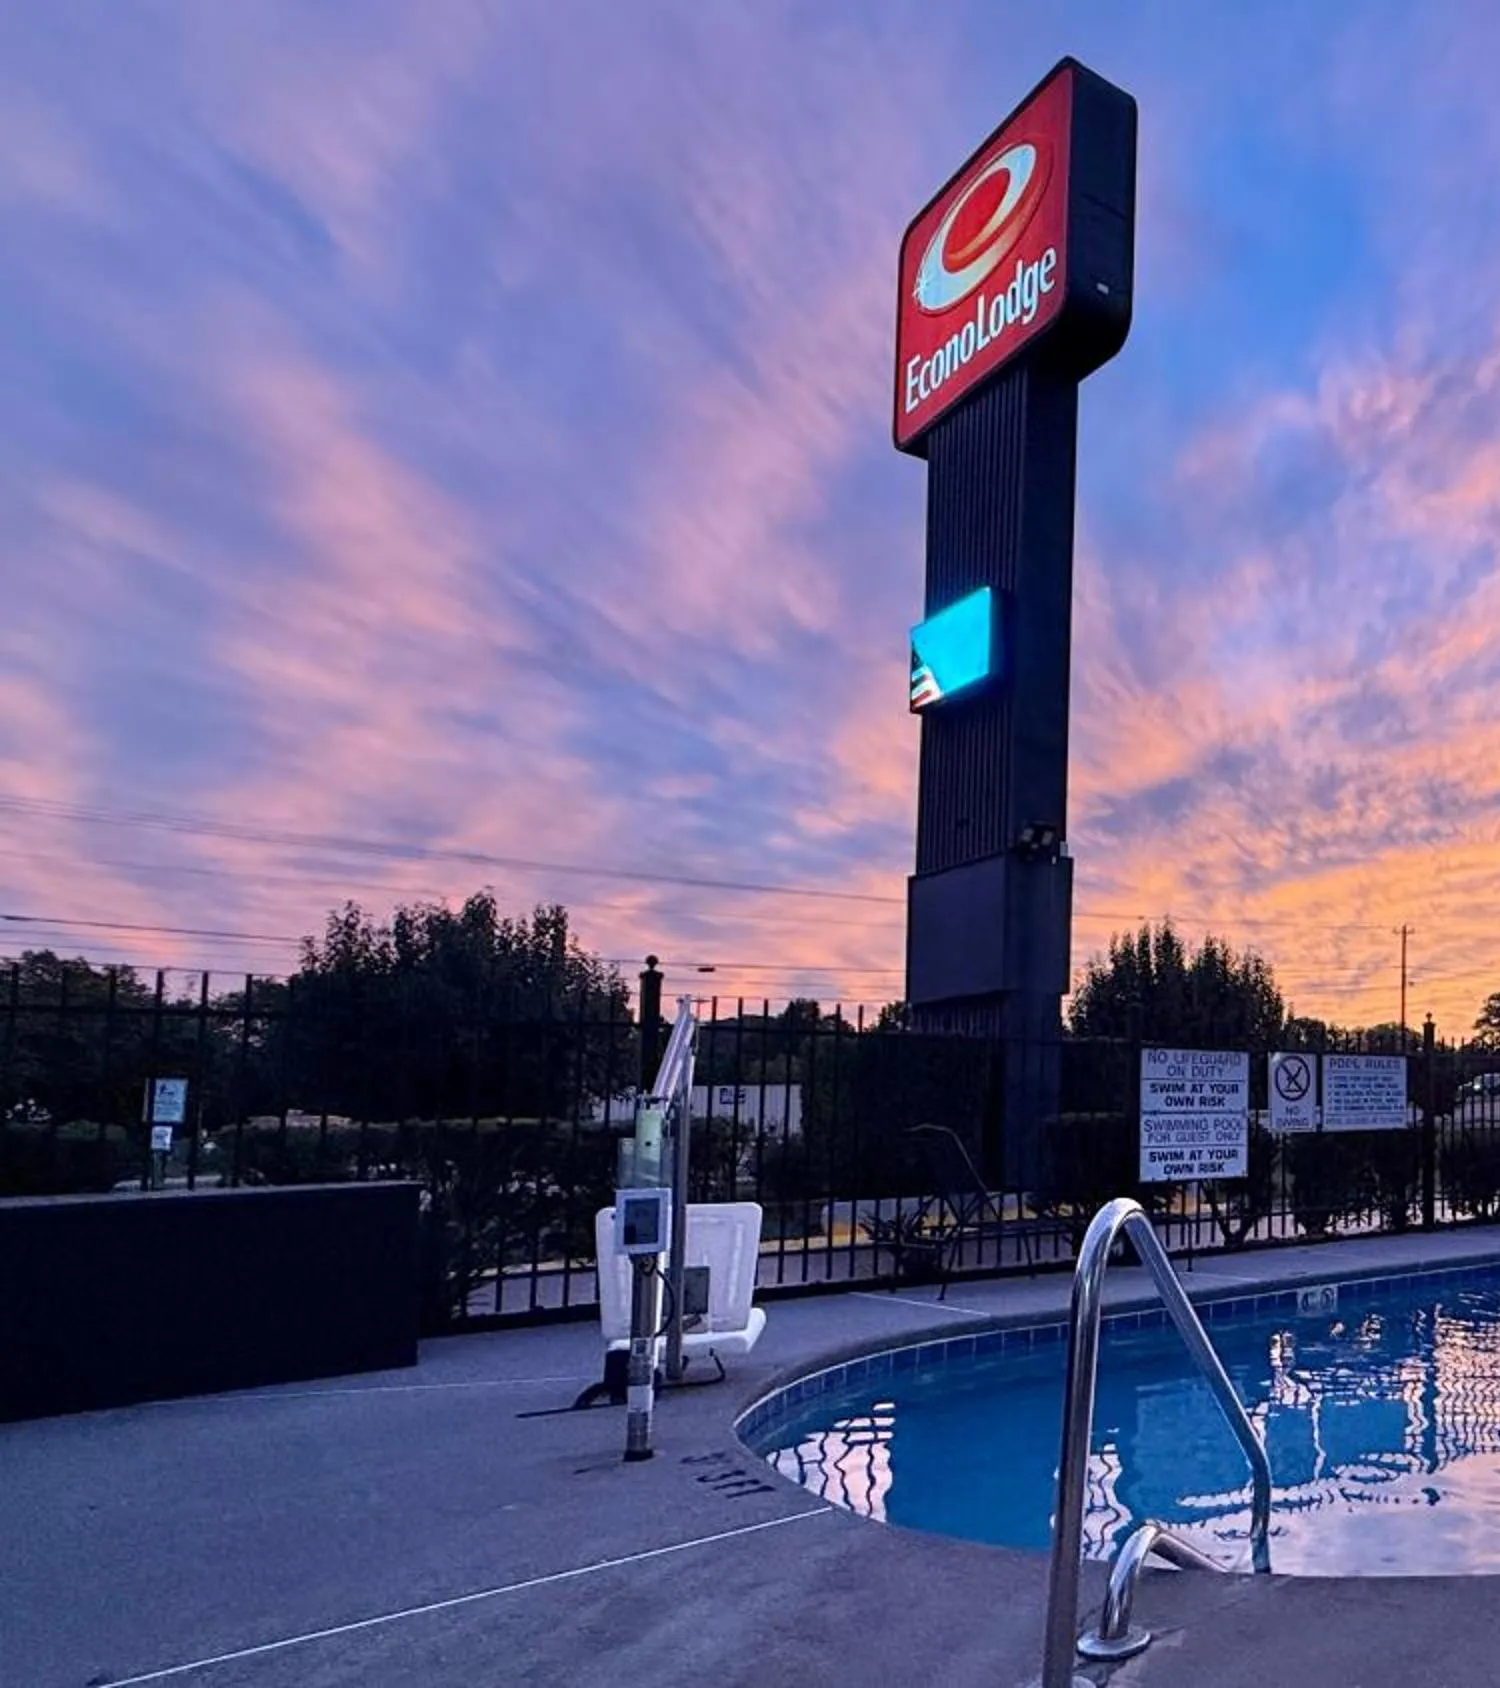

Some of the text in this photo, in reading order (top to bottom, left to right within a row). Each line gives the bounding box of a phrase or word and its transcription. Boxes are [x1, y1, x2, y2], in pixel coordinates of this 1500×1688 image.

[1147, 1051, 1241, 1065] NO LIFEGUARD
[1167, 1065, 1223, 1077] ON DUTY
[1149, 1083, 1239, 1094] SWIM AT YOUR
[1164, 1095, 1226, 1107] OWN RISK
[1144, 1118, 1245, 1132] SWIMMING POOL
[1148, 1131, 1240, 1143] FOR GUEST ONLY
[1149, 1149, 1238, 1162] SWIM AT YOUR
[1163, 1162, 1225, 1175] OWN RISK
